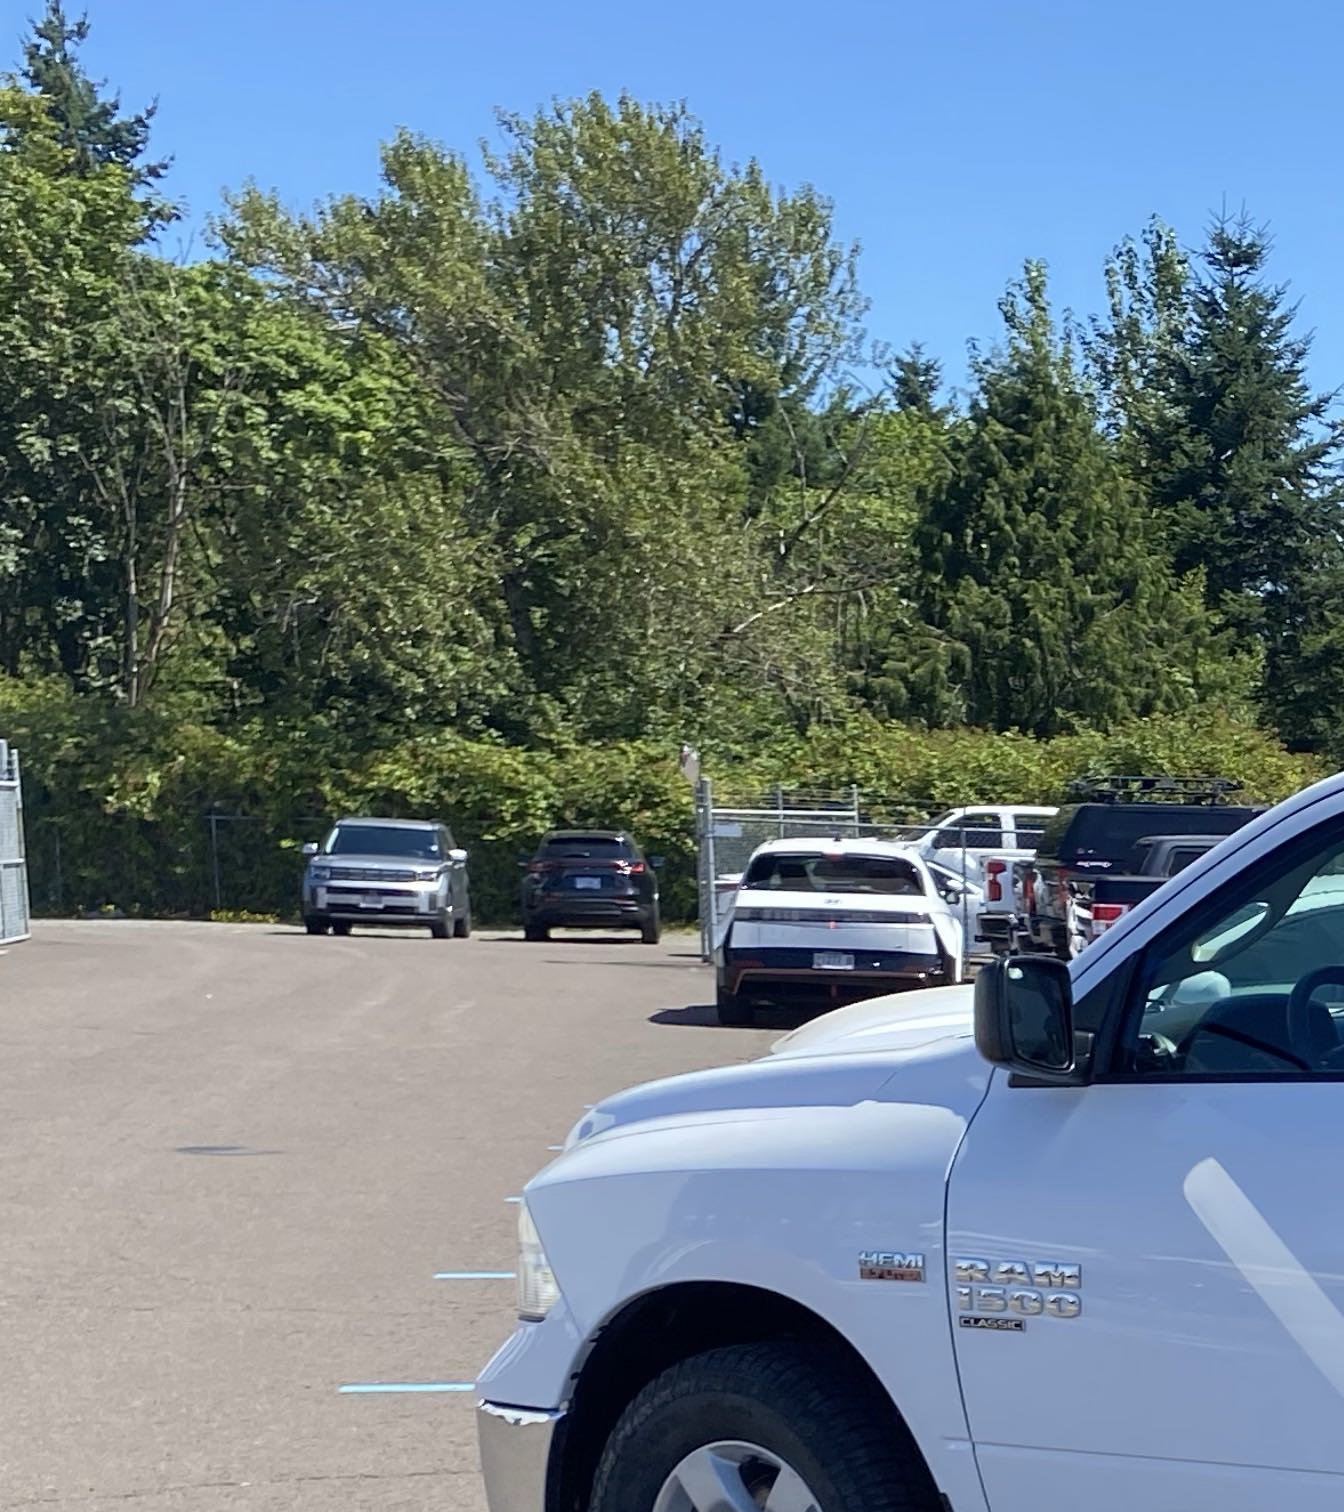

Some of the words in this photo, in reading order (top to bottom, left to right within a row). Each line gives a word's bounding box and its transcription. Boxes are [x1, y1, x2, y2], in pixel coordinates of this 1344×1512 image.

[858, 1251, 925, 1268] HEMI
[955, 1257, 1082, 1289] RAM
[955, 1285, 1082, 1319] 1500
[960, 1317, 1023, 1331] CLASSIC
